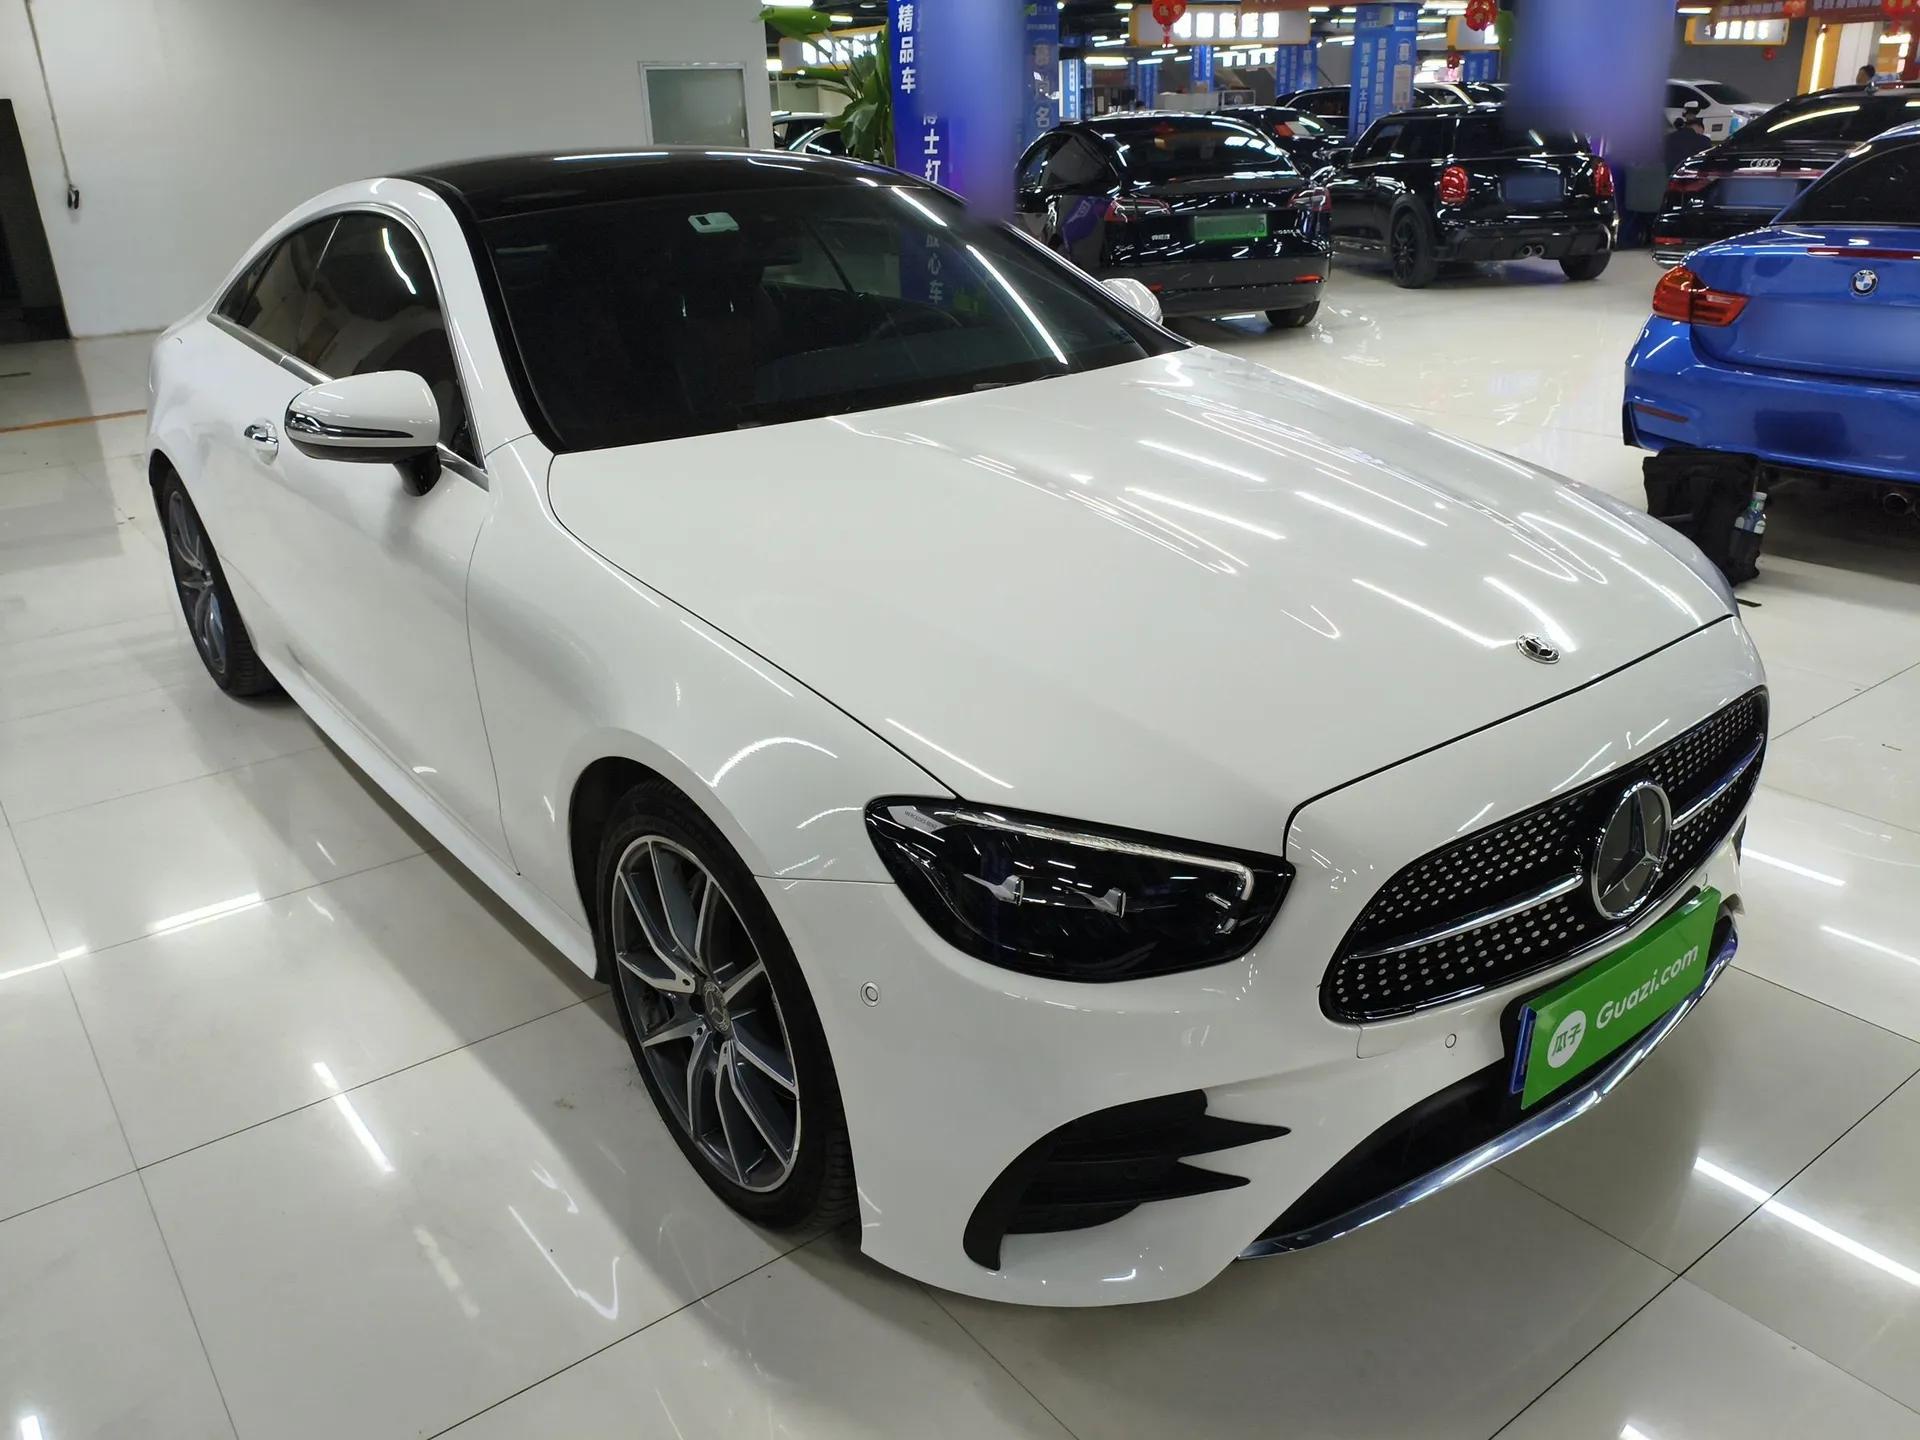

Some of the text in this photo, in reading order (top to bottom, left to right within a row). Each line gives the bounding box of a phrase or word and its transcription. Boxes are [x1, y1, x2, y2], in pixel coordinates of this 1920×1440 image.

[897, 0, 917, 95] 精品车
[1596, 944, 1699, 1030] Guazi.com
[1551, 1023, 1582, 1057] 瓜子
